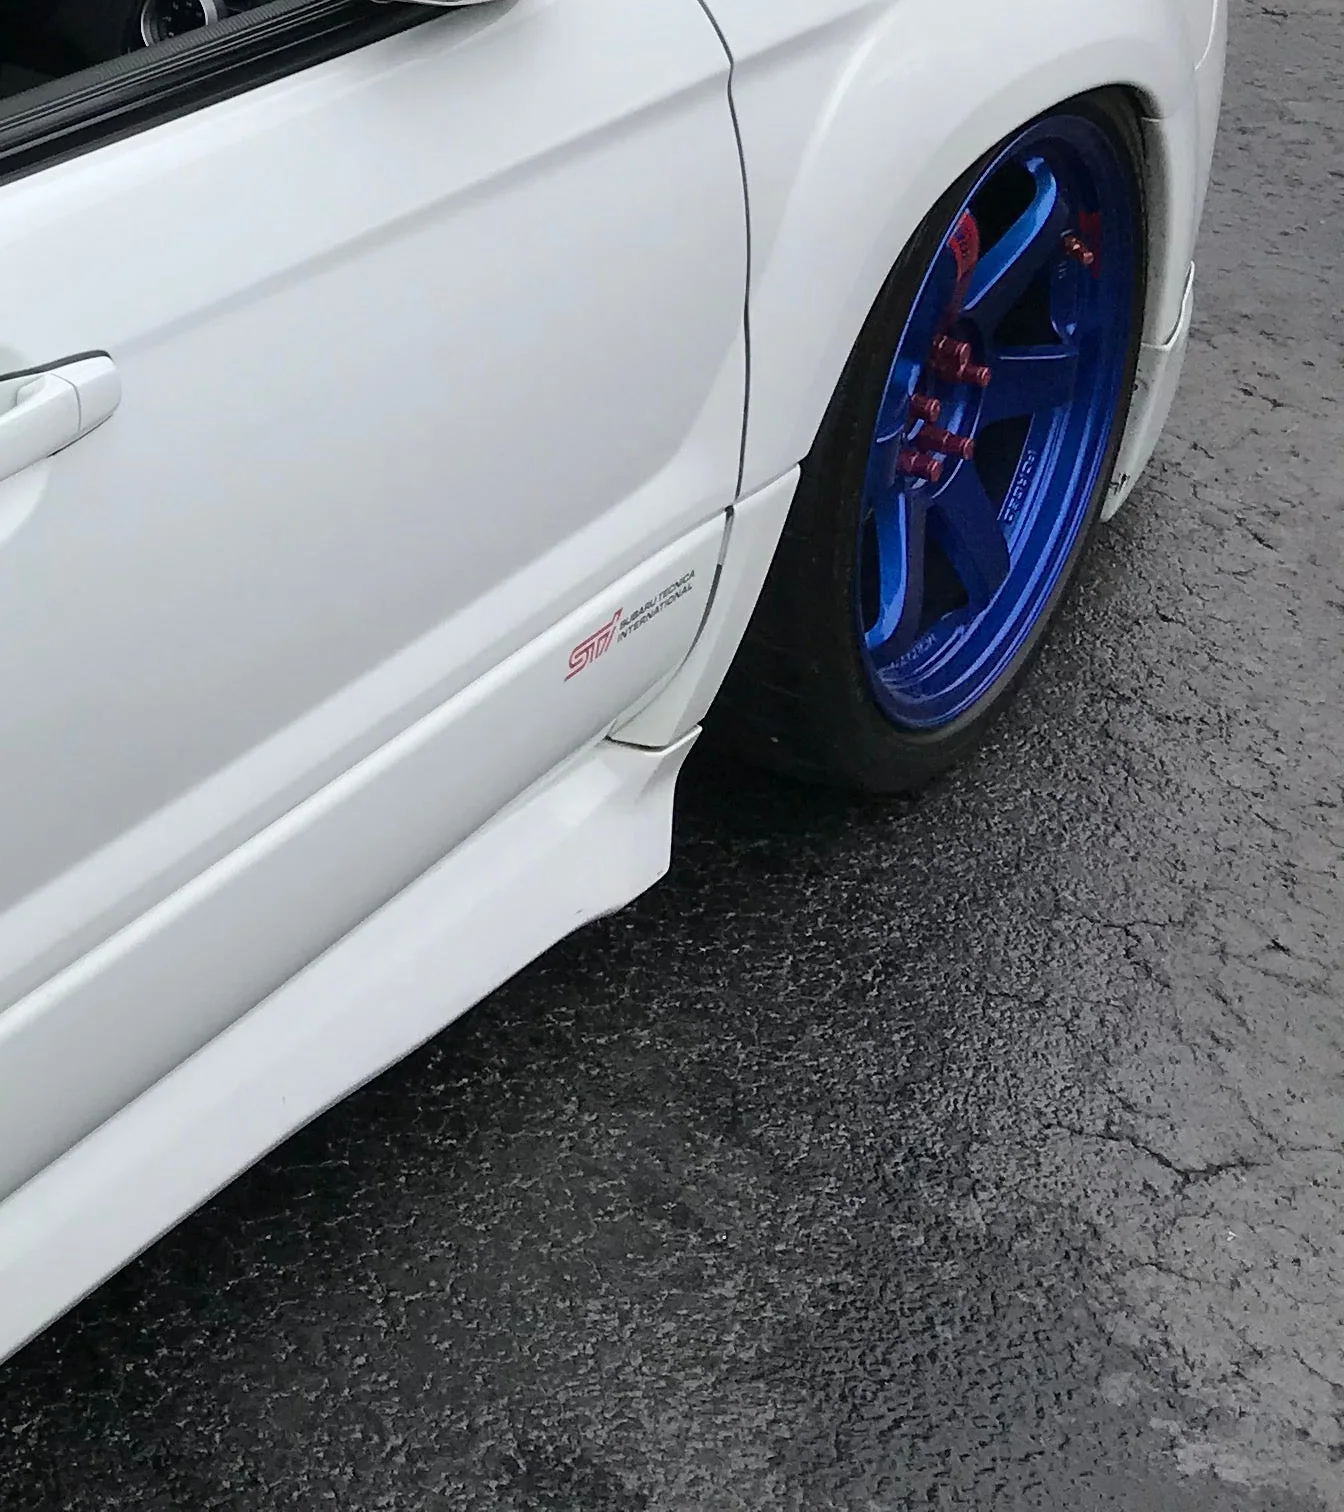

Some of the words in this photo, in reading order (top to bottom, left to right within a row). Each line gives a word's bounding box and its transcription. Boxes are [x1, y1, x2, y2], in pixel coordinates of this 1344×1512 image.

[617, 583, 693, 643] INTERNATIONAL
[619, 596, 657, 630] SUBARU
[658, 569, 695, 602] TECNICA
